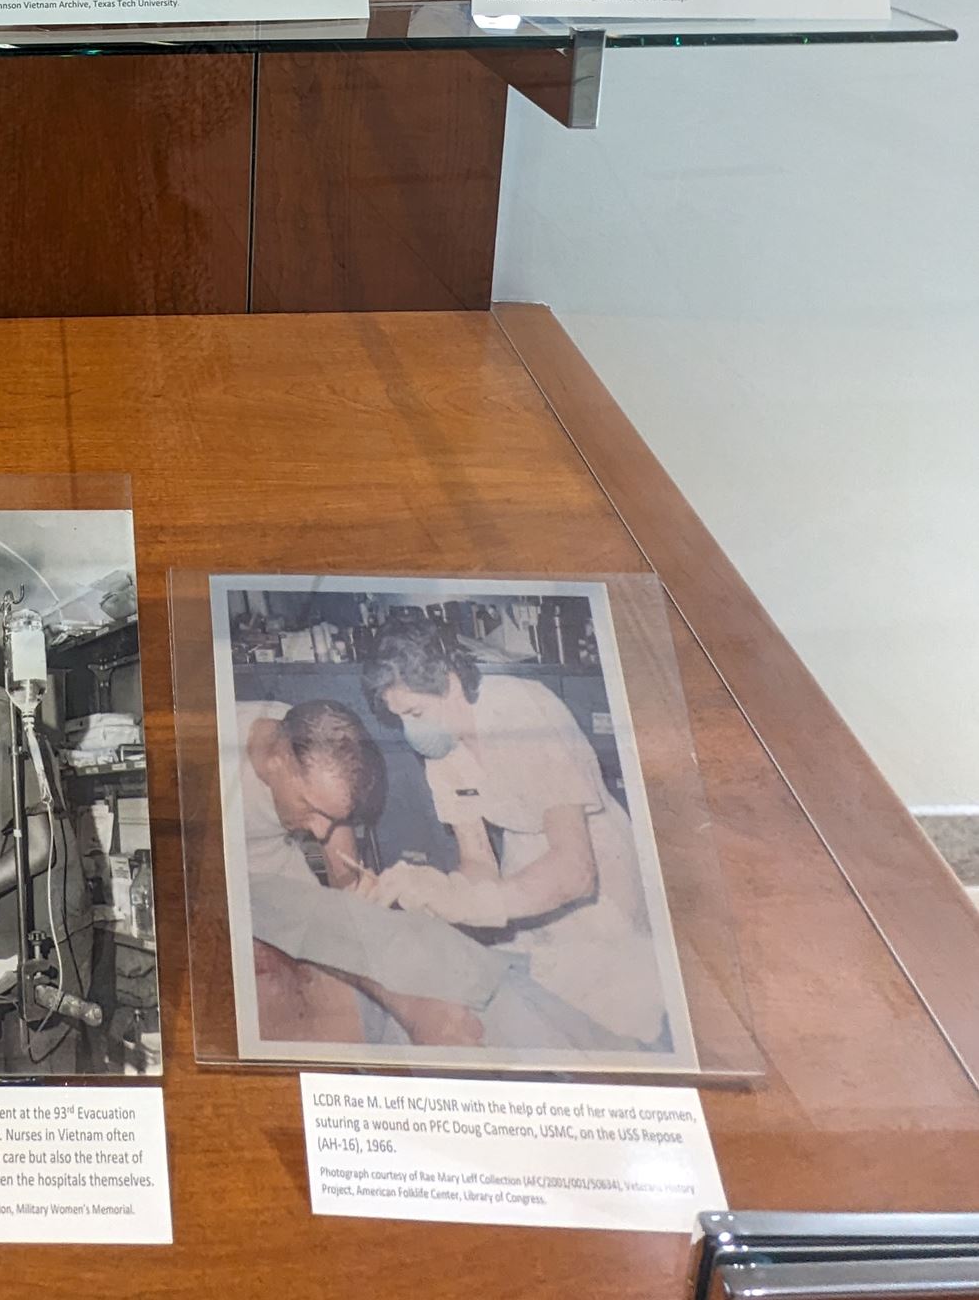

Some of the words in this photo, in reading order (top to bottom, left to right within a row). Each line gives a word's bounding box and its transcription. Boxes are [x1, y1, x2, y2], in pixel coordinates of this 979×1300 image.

[315, 1116, 360, 1132] suturing
[363, 1119, 369, 1129] a
[372, 1118, 410, 1131] wound
[412, 1122, 427, 1132] on
[429, 1119, 450, 1133] PFC
[452, 1120, 482, 1138] Doug
[483, 1122, 537, 1139] Cameron,
[539, 1124, 577, 1140] USMC,
[579, 1129, 594, 1140] on
[596, 1127, 615, 1141] the
[617, 1128, 640, 1142] USS
[641, 1129, 683, 1145] Repose
[16, 1172, 34, 1186] the
[38, 1172, 86, 1188] hospitals
[89, 1172, 154, 1186] themselves.
